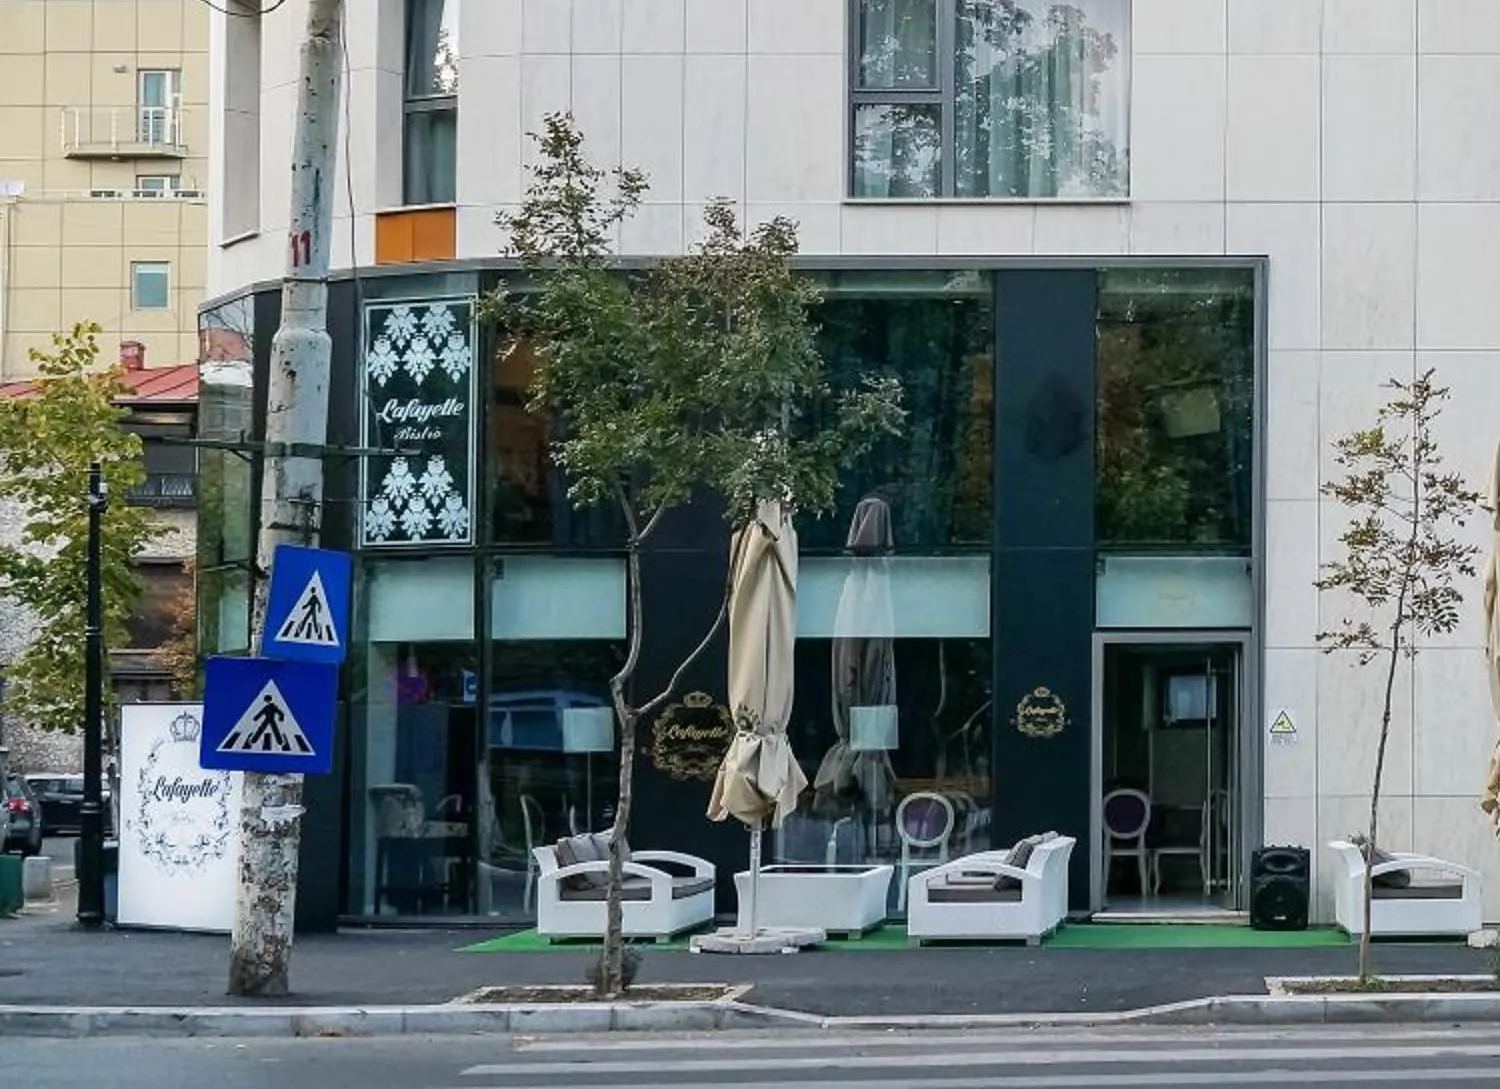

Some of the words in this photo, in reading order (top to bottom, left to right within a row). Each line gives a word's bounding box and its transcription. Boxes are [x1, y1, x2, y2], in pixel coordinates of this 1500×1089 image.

[292, 231, 311, 267] 11
[380, 397, 465, 423] Lafayette
[152, 776, 220, 803] Lafayette
